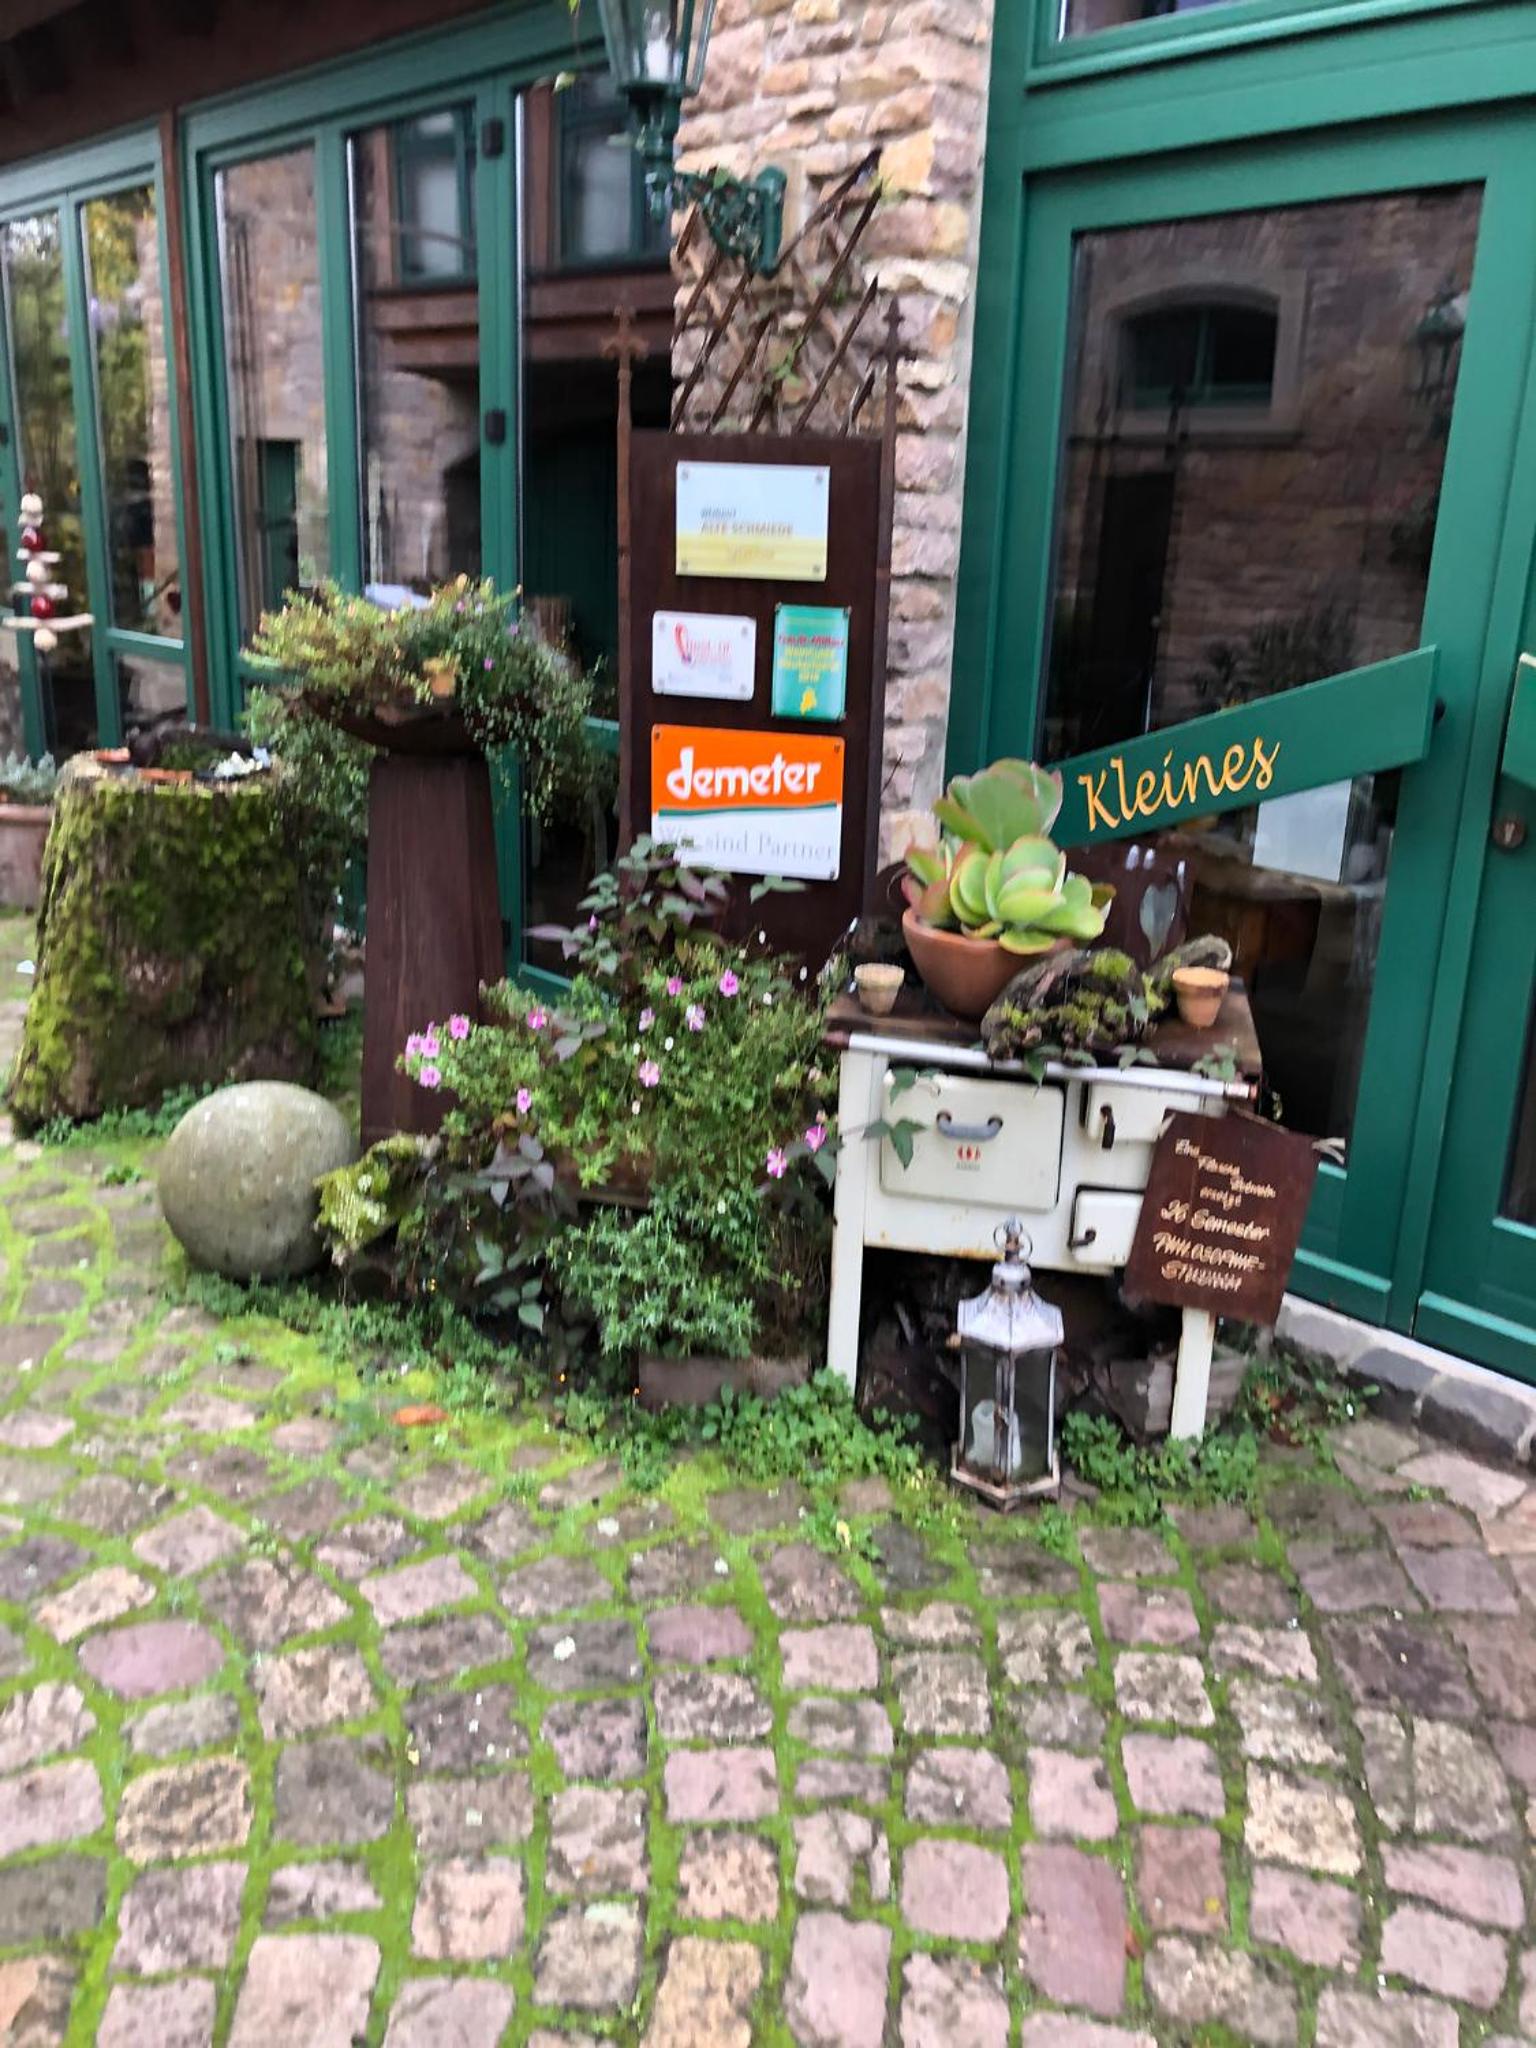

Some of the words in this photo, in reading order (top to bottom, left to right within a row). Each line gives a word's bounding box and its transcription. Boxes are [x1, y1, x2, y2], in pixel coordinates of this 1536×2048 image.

[666, 746, 823, 801] demeter
[1077, 736, 1281, 832] Kleines
[758, 832, 832, 861] Partner
